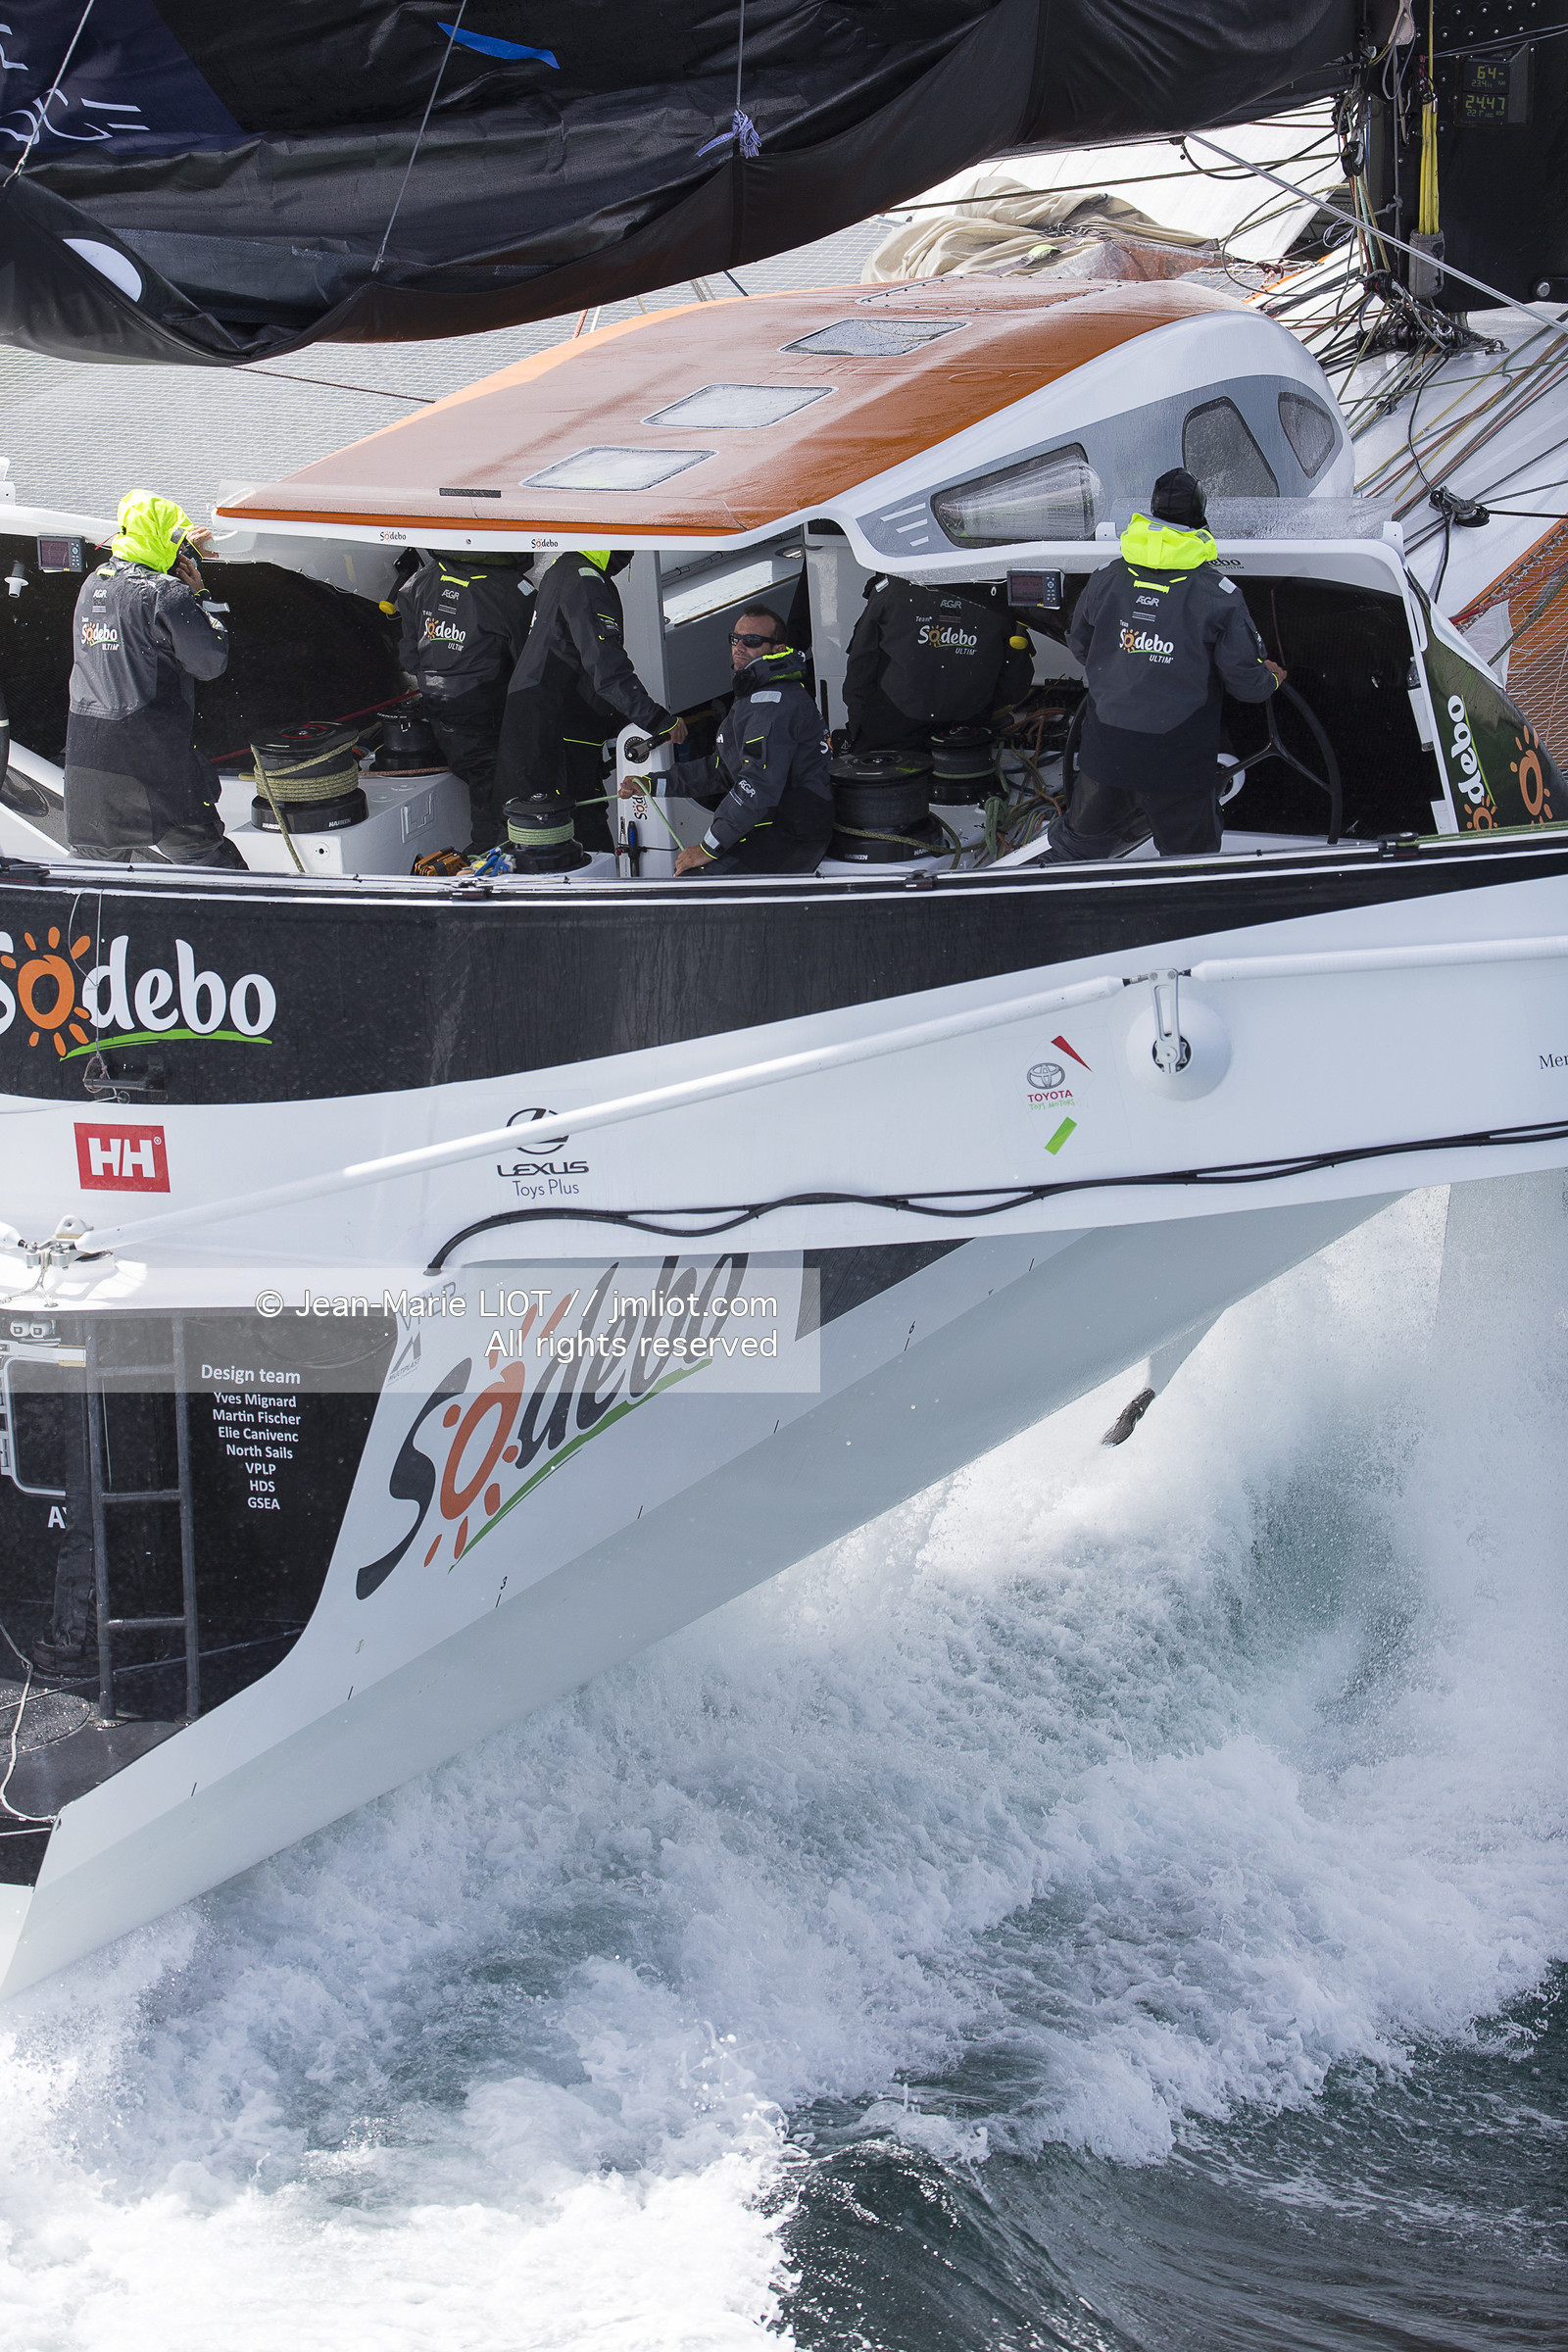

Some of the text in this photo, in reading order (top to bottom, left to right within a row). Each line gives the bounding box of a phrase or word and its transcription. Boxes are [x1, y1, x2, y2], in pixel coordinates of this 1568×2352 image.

[1465, 95, 1505, 110] 24.47
[379, 531, 407, 541] Sodebo
[531, 538, 559, 549] Sodebo
[81, 623, 118, 645] Sodebo
[423, 617, 466, 642] Sodebo
[917, 625, 977, 646] Sodebo
[1119, 627, 1174, 655] Sodebo
[1447, 695, 1493, 832] odebo
[0, 931, 277, 1037] odebo
[1027, 1089, 1073, 1103] TOYOTA
[496, 1160, 590, 1178] LEXUS
[512, 1178, 580, 1200] Toys Plus
[201, 1364, 301, 1385] Design team
[214, 1392, 297, 1408] Yves Mignard
[213, 1409, 301, 1425] Martin Fischer
[356, 1252, 748, 1600] Sodebo
[218, 1427, 299, 1443] Elie Canivenc
[226, 1445, 293, 1459] North Sails
[245, 1462, 276, 1475] VPLP
[249, 1480, 275, 1493] HDS
[247, 1497, 280, 1510] GSEA
